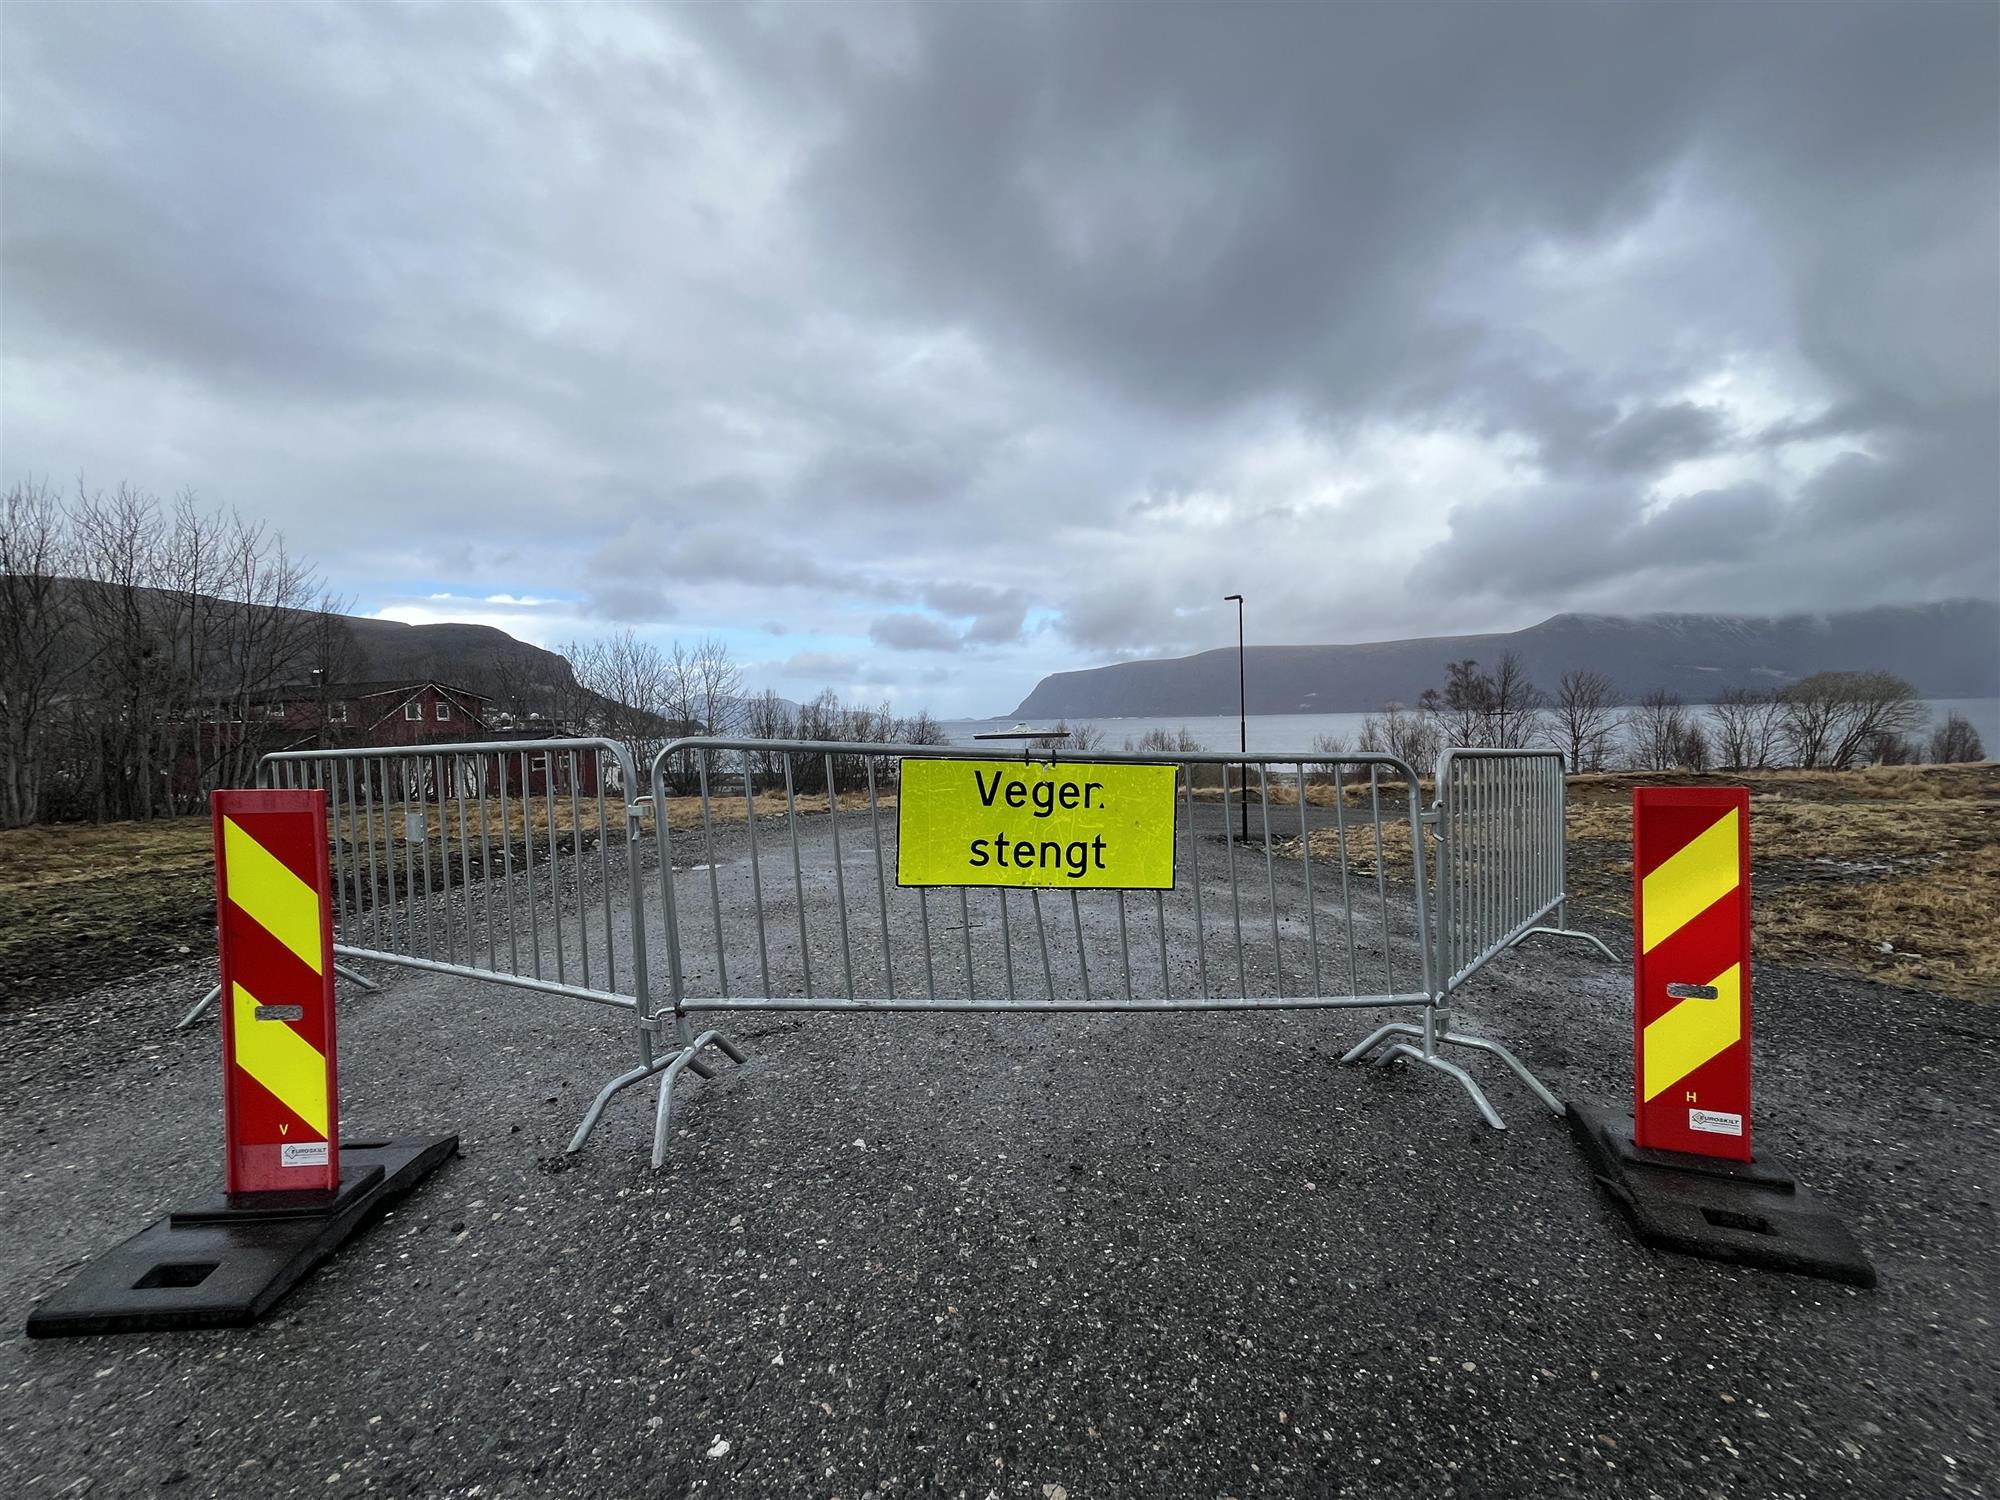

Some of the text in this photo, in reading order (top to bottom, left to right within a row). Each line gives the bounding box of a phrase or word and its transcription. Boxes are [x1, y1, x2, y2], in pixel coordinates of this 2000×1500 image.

[969, 832, 1107, 878] stengt
[1686, 1091, 1697, 1103] H
[279, 1123, 289, 1136] V
